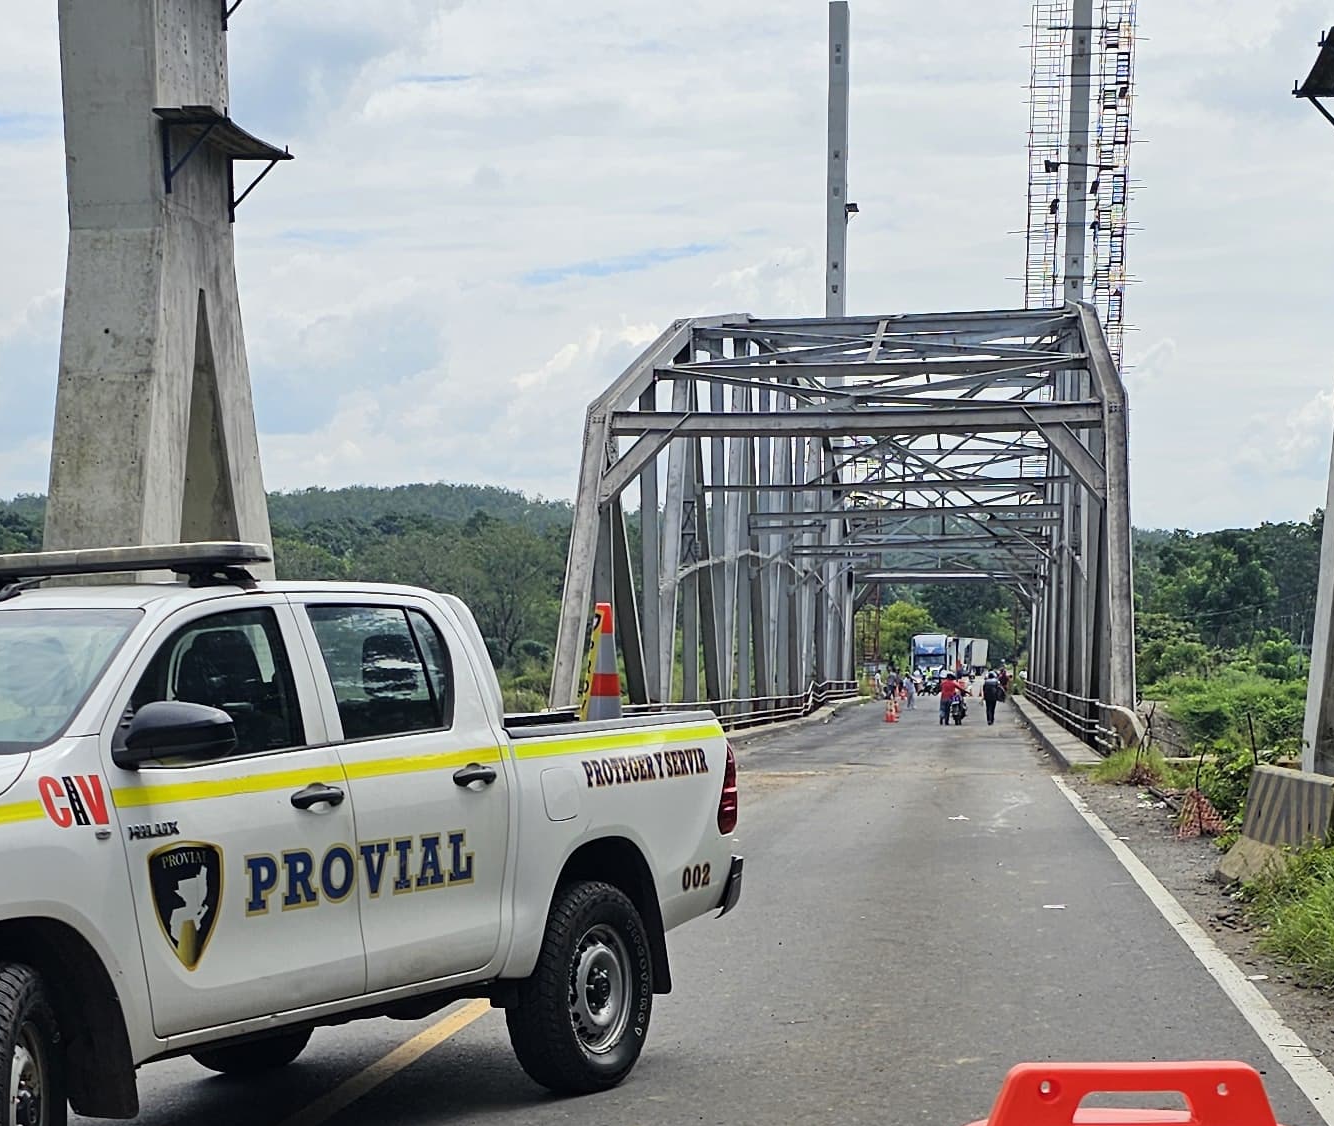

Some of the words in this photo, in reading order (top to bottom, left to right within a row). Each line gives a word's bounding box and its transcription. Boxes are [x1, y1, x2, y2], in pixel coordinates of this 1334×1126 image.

[581, 755, 656, 788] PROTEGER
[654, 752, 665, 779] Y
[664, 748, 709, 778] SERVIR
[244, 829, 474, 917] PROVIAL
[682, 862, 711, 891] 002
